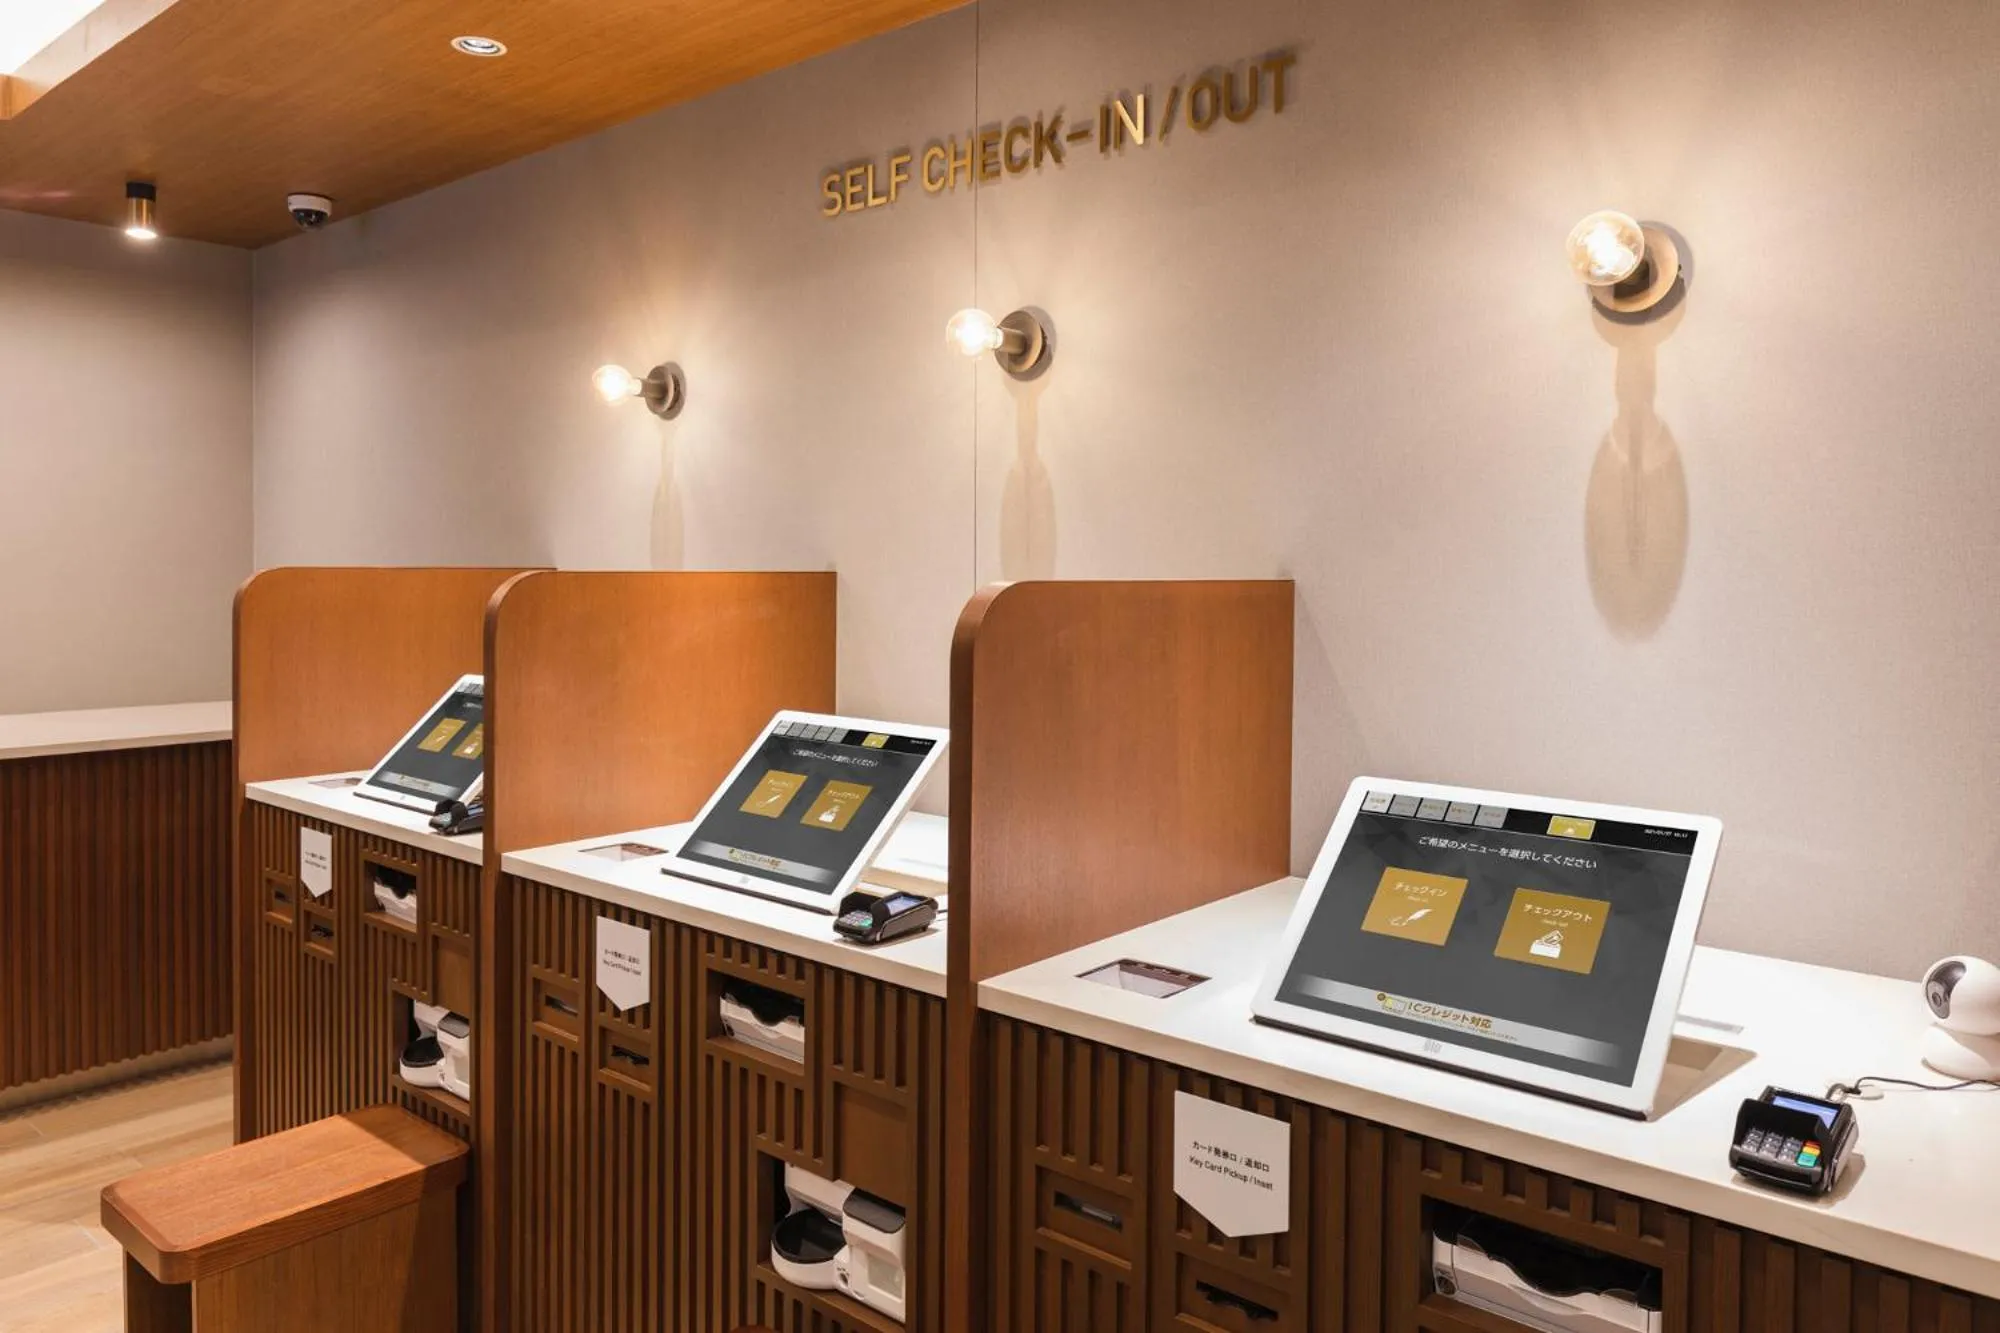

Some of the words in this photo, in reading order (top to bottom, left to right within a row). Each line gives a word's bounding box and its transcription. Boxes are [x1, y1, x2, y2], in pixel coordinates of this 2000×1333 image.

[823, 154, 911, 218] SELF
[1417, 836, 1598, 869] ご希望のメニューを選択してください
[1394, 881, 1448, 897] チェックイン
[1523, 903, 1593, 922] チェックアウト
[1408, 1002, 1493, 1029] ICクレジット対応
[1189, 1156, 1203, 1168] Key
[1204, 1160, 1222, 1173] Card
[1223, 1166, 1248, 1183] Pickup
